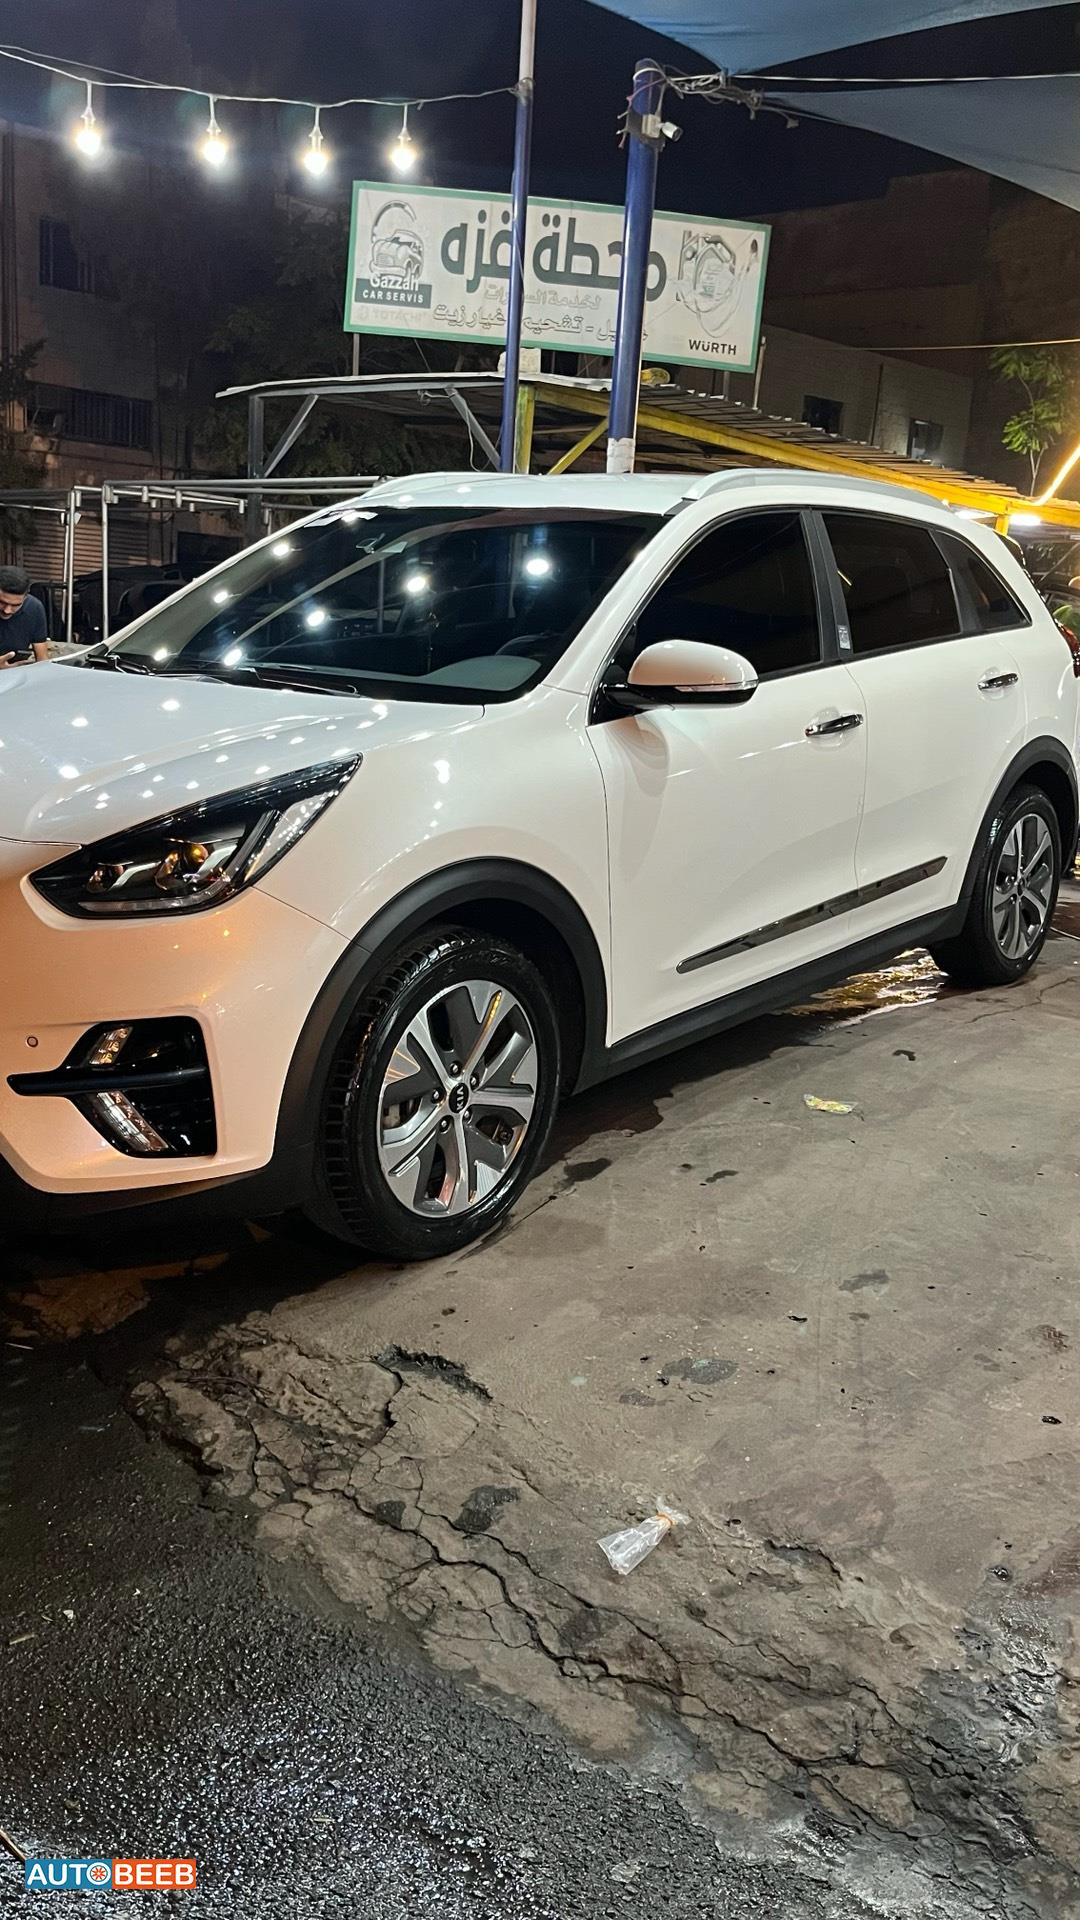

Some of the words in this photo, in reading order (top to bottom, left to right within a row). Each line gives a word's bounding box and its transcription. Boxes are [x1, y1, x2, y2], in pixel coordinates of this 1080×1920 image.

[370, 273, 419, 291] Gazzah
[362, 289, 383, 300] CAR
[385, 291, 424, 303] SERVIS
[484, 283, 547, 305] السرات
[688, 339, 737, 355] WÜRTH
[456, 1085, 465, 1111] KIA
